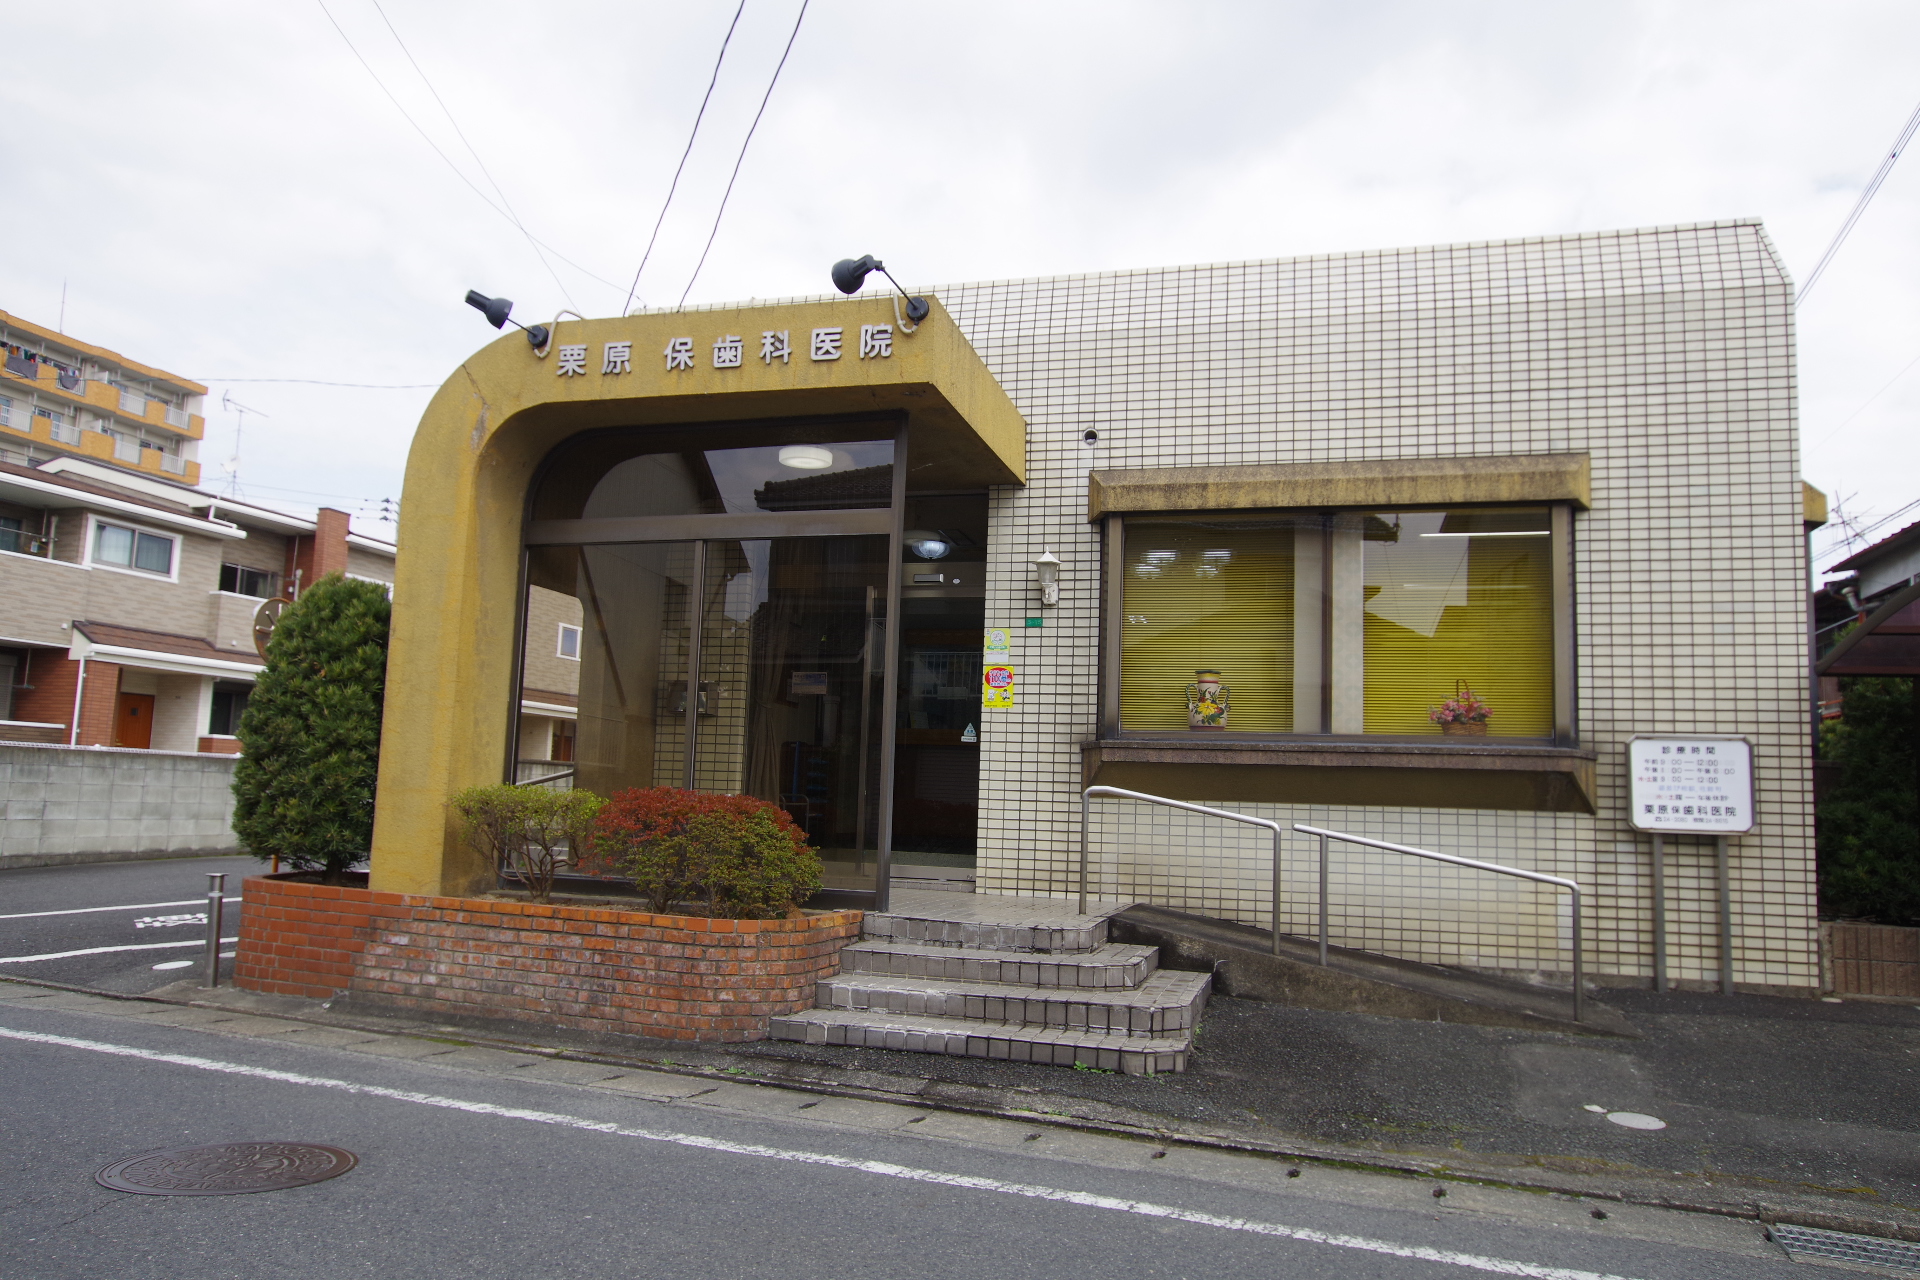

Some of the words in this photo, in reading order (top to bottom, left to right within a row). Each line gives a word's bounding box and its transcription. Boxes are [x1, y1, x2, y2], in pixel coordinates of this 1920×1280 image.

[1662, 746, 1716, 755] 診療時間
[1644, 804, 1737, 817] 栗原保歯科医院
